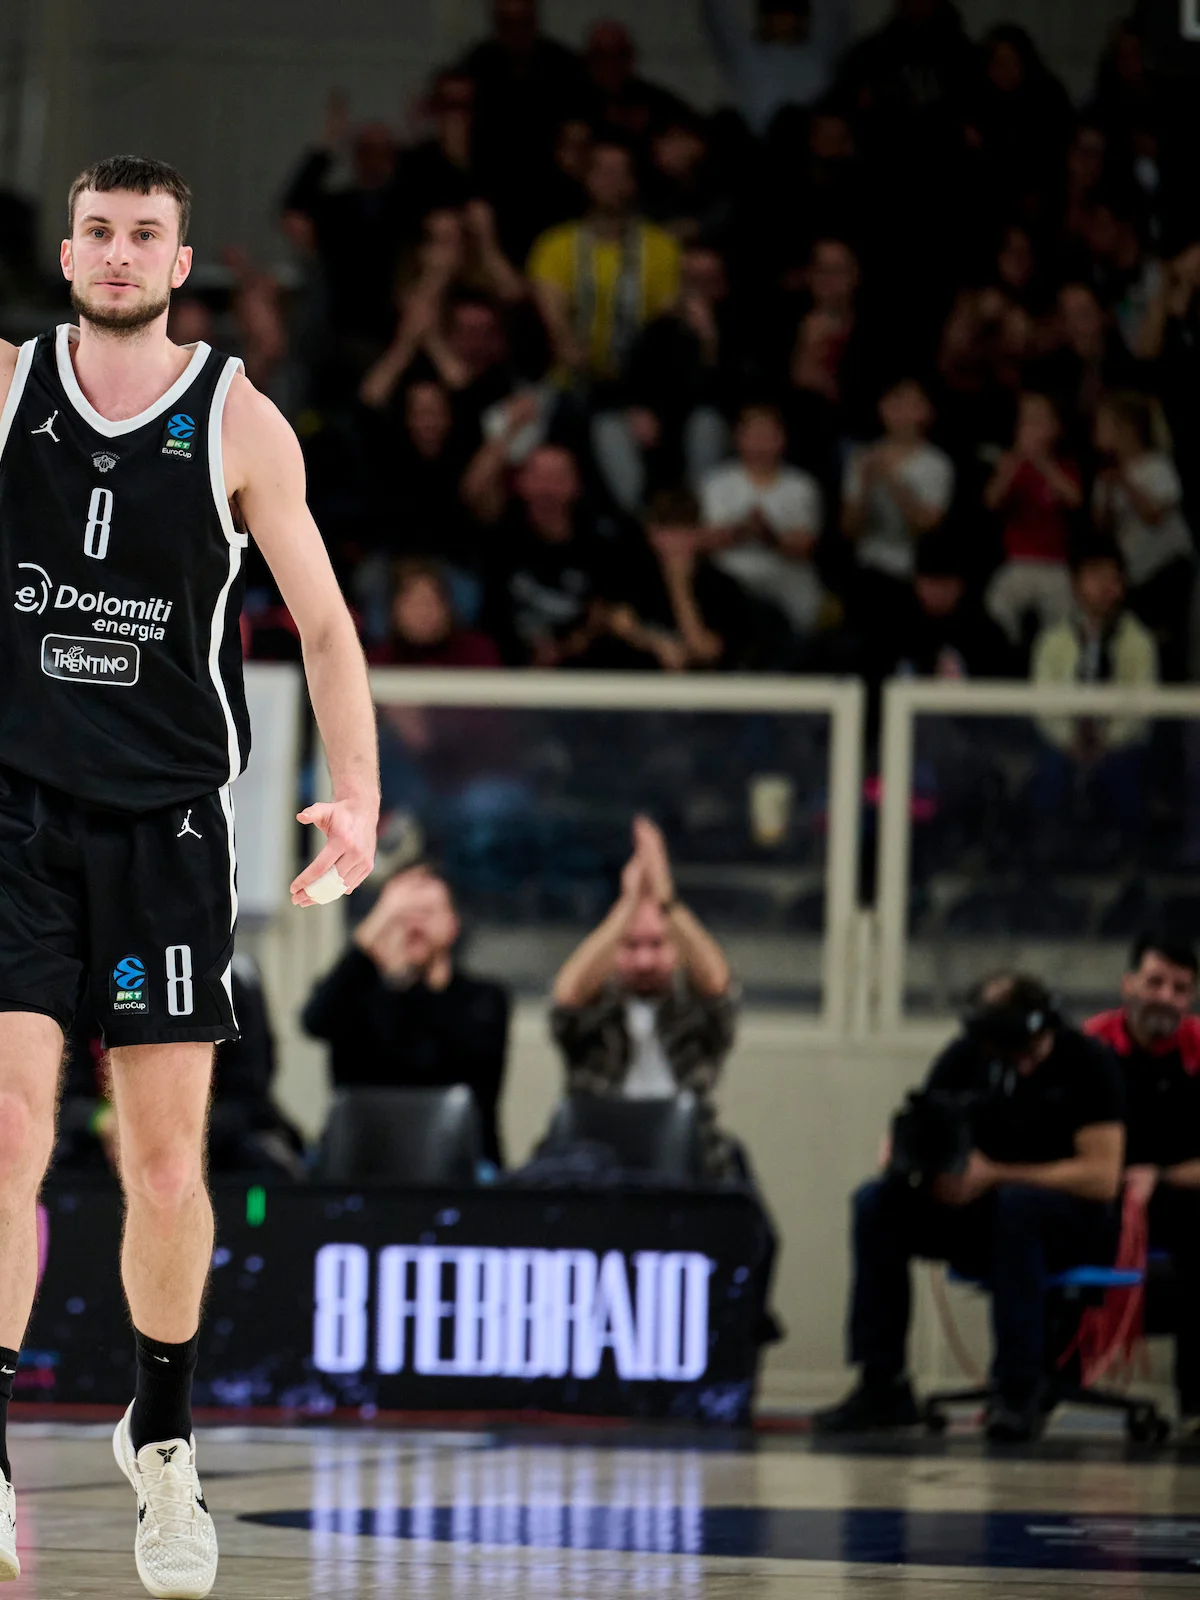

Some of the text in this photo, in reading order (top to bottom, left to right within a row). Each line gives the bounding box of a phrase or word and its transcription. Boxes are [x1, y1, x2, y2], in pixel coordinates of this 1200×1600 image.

[162, 447, 192, 458] EuroCup
[84, 488, 113, 560] 8
[54, 585, 173, 623] Dolomiti
[92, 619, 165, 641] energia
[52, 649, 128, 674] TRENTINO
[165, 945, 193, 1016] 8
[114, 1002, 146, 1010] EuroCup
[313, 1243, 711, 1381] 8 FEBBRAIO
